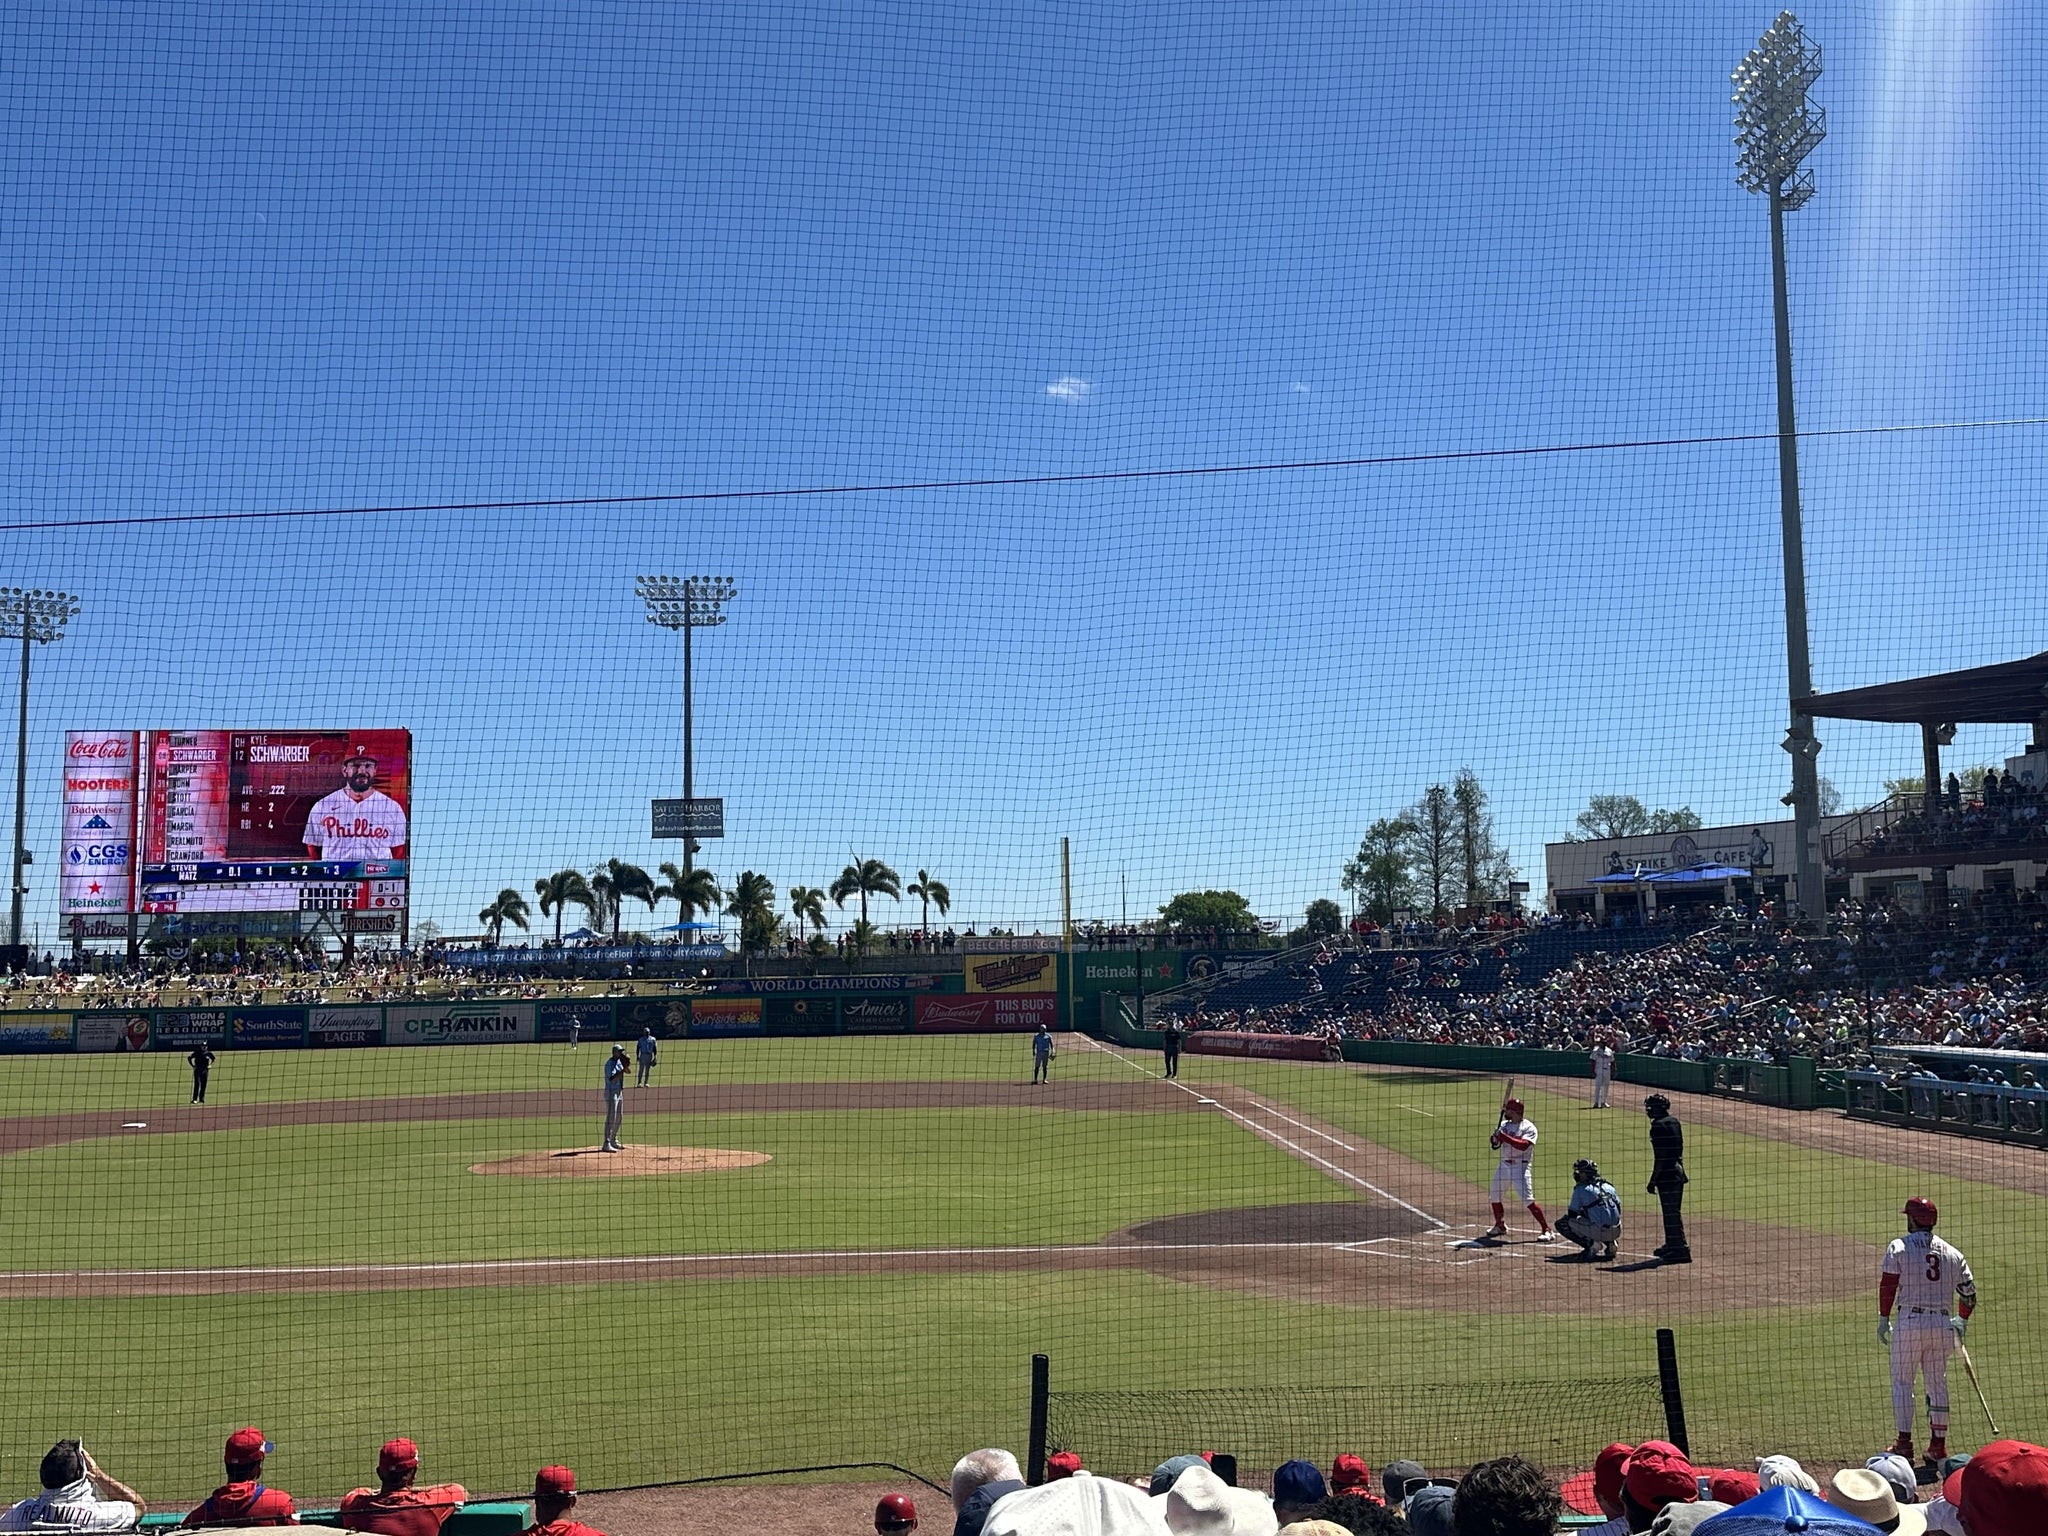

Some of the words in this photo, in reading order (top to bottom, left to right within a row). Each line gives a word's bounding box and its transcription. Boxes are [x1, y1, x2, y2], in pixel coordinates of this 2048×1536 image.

[250, 735, 268, 745] KYLE
[250, 746, 310, 762] SCHWARBER
[356, 746, 365, 755] P
[68, 778, 130, 790] HOOTERS
[242, 785, 253, 796] AVG
[268, 785, 286, 795] .222
[70, 804, 124, 814] Budweiser
[241, 802, 250, 812] HR
[268, 802, 274, 812] 2
[684, 804, 720, 812] HARBOR
[170, 822, 194, 832] MARSH
[268, 820, 274, 830] 4
[322, 816, 389, 838] Phillies
[170, 836, 203, 846] REALMUTO
[88, 844, 128, 858] CGS
[88, 858, 126, 866] ENERGY
[1626, 858, 1667, 868] STRIKE
[1714, 850, 1746, 863] CAFE
[171, 864, 198, 872] STEVEN
[228, 866, 240, 877] 0.1
[268, 866, 272, 876] 1
[302, 865, 308, 876] 2
[334, 865, 340, 876] 3
[181, 892, 186, 900] 0
[348, 888, 353, 898] 2
[68, 898, 122, 908] Heineken
[348, 900, 352, 909] 2
[68, 918, 128, 938] Phillies
[183, 921, 240, 935] BayCare
[340, 914, 396, 932] THRESHERS
[968, 940, 1018, 950] BELCHER
[1022, 938, 1058, 950] BINGO
[1086, 964, 1153, 978] Heinekn
[750, 980, 805, 992] WORLD
[808, 976, 900, 991] CHAMPIONS
[540, 1004, 611, 1014] CANDLEWOOD
[844, 998, 908, 1016] Amici's
[994, 1000, 1018, 1011] THIS
[1021, 999, 1054, 1010] BUD'S
[925, 1005, 982, 1018] Budweiser
[313, 1012, 376, 1030] Yuengling
[692, 1012, 736, 1027] Surfside
[995, 1012, 1016, 1024] FOR
[1020, 1012, 1044, 1024] YOU.
[156, 1026, 225, 1034] RESOURCE
[246, 1020, 303, 1030] SouthState
[324, 1032, 366, 1042] LAGER
[484, 1032, 518, 1040] EXPERTS
[1926, 1254, 1941, 1282] 3
[22, 1504, 93, 1528] REALMUTO
